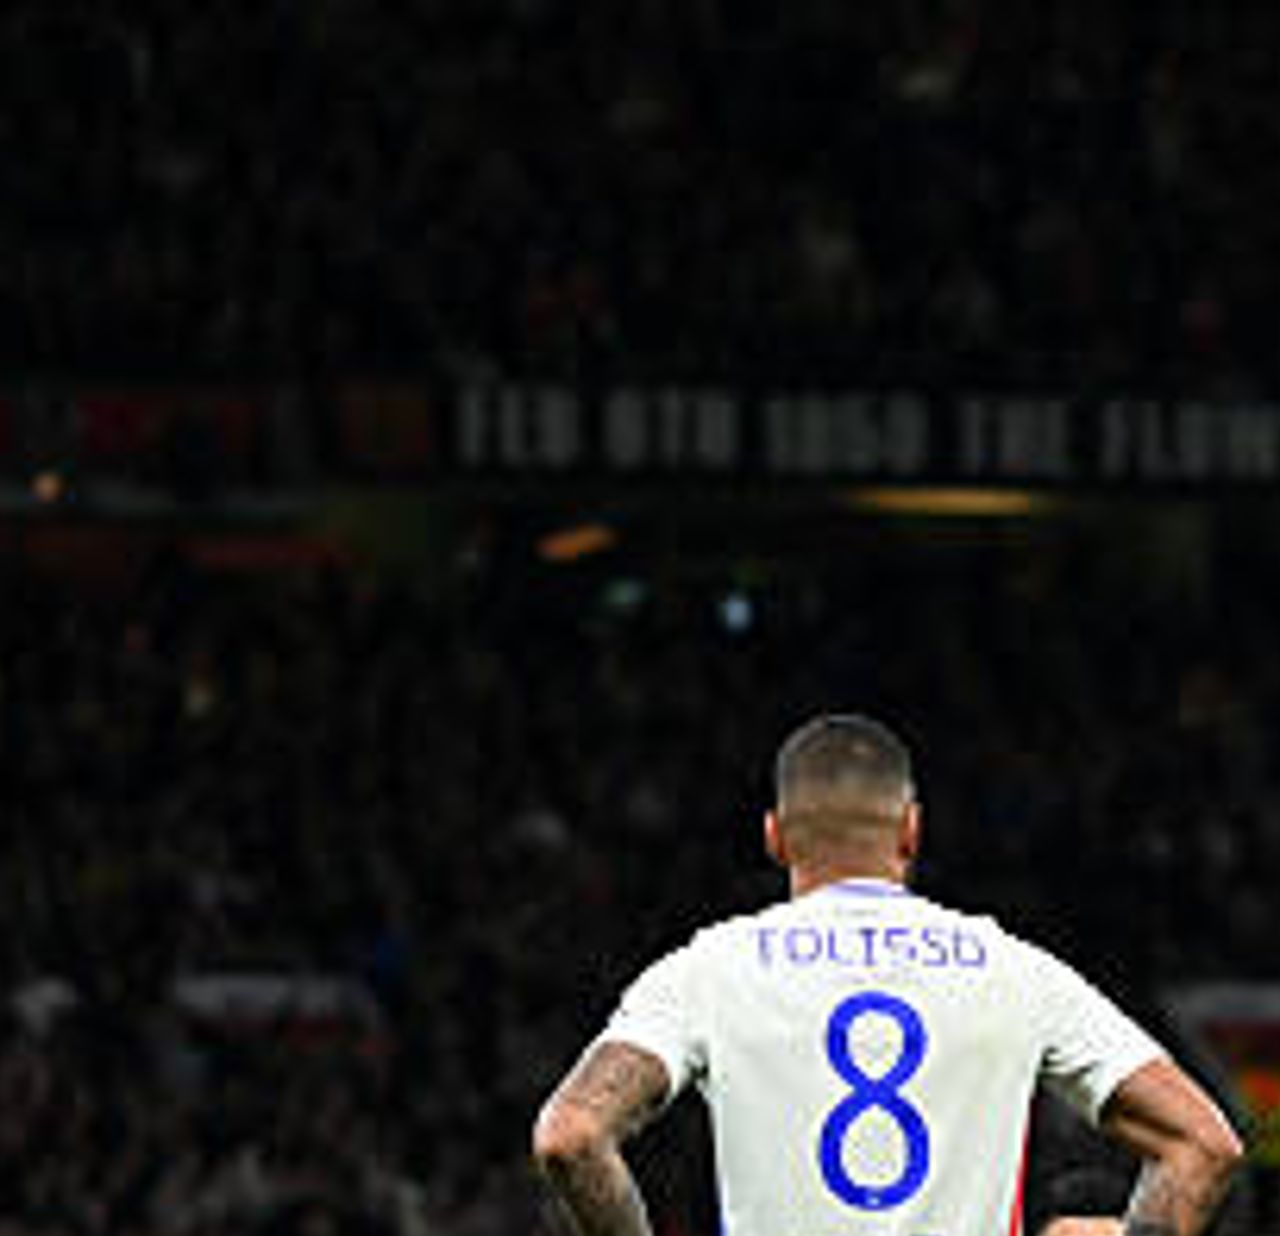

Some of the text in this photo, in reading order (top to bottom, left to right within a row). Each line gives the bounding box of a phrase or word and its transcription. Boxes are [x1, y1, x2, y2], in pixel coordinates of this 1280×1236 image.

[956, 394, 1074, 474] THE
[756, 927, 987, 967] TOLISSO
[820, 990, 930, 1211] 8
